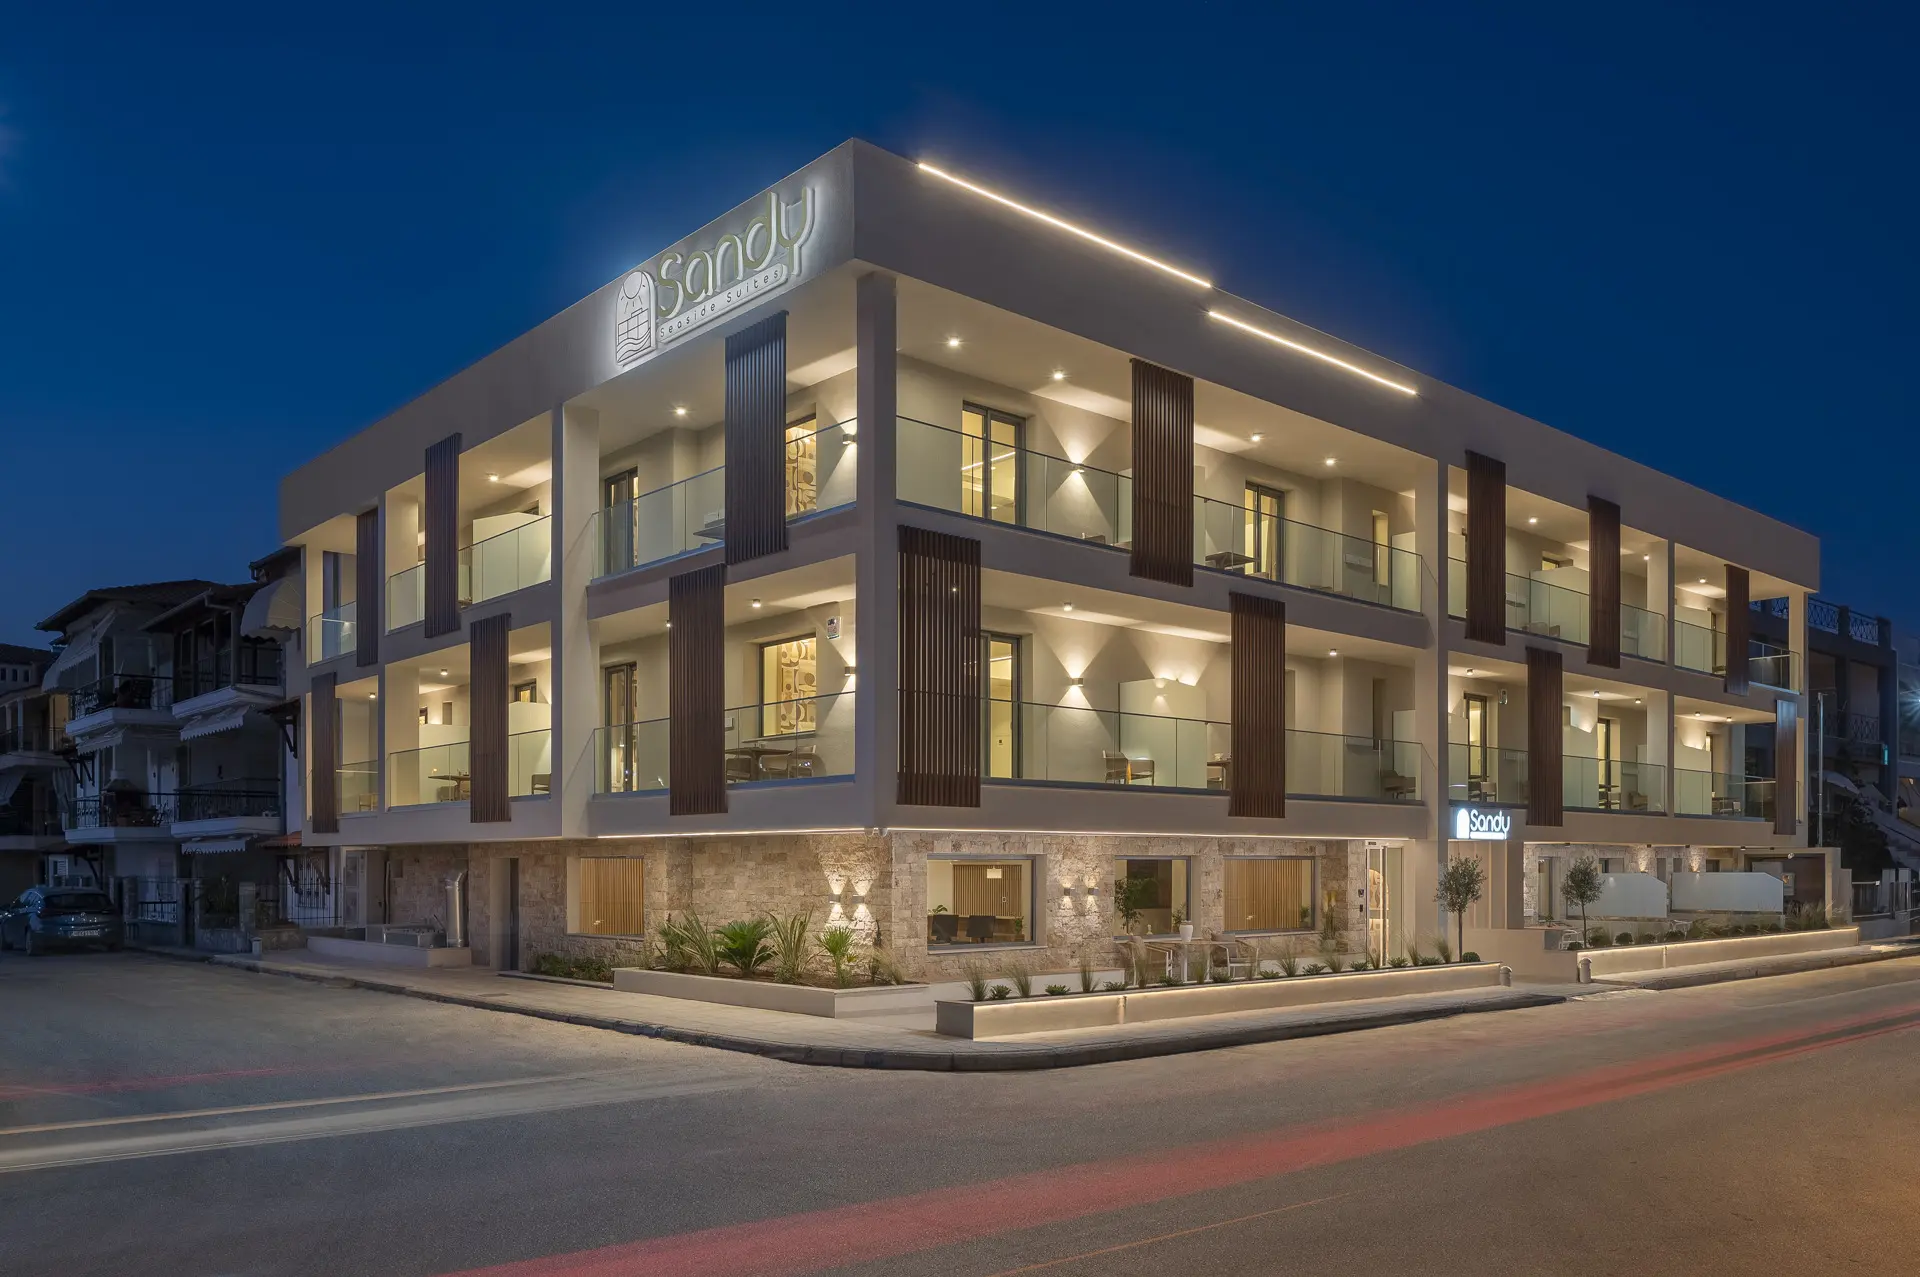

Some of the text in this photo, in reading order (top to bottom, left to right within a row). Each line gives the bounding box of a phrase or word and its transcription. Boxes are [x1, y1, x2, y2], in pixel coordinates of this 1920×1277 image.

[660, 269, 779, 338] Seaside Suites
[1470, 809, 1510, 840] Sandy
